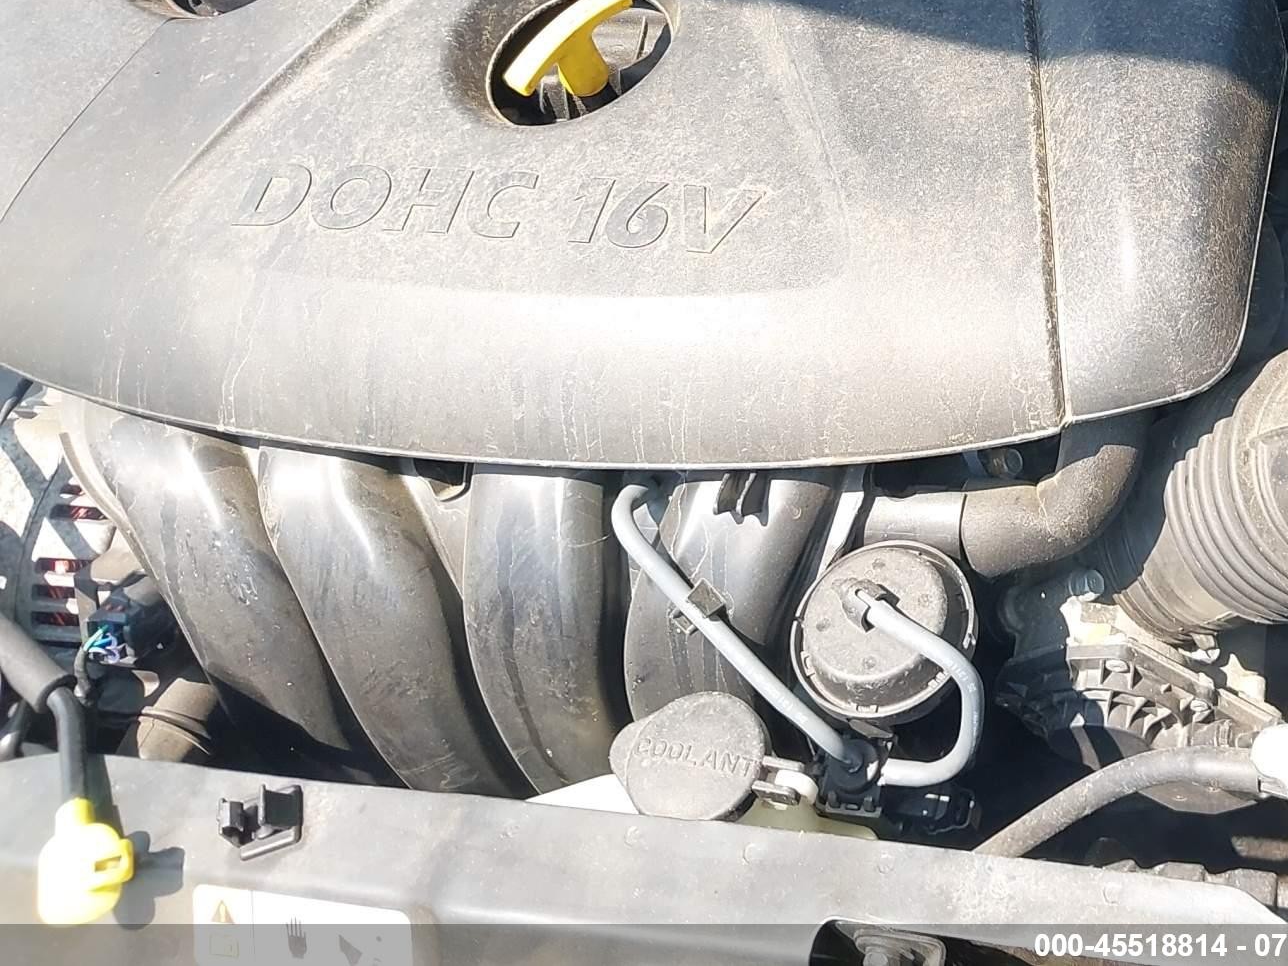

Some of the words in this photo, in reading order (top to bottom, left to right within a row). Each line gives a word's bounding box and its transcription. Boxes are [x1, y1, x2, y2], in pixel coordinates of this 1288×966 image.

[231, 163, 540, 239] DOHC
[568, 176, 767, 254] 16V
[635, 736, 760, 778] COOLANT
